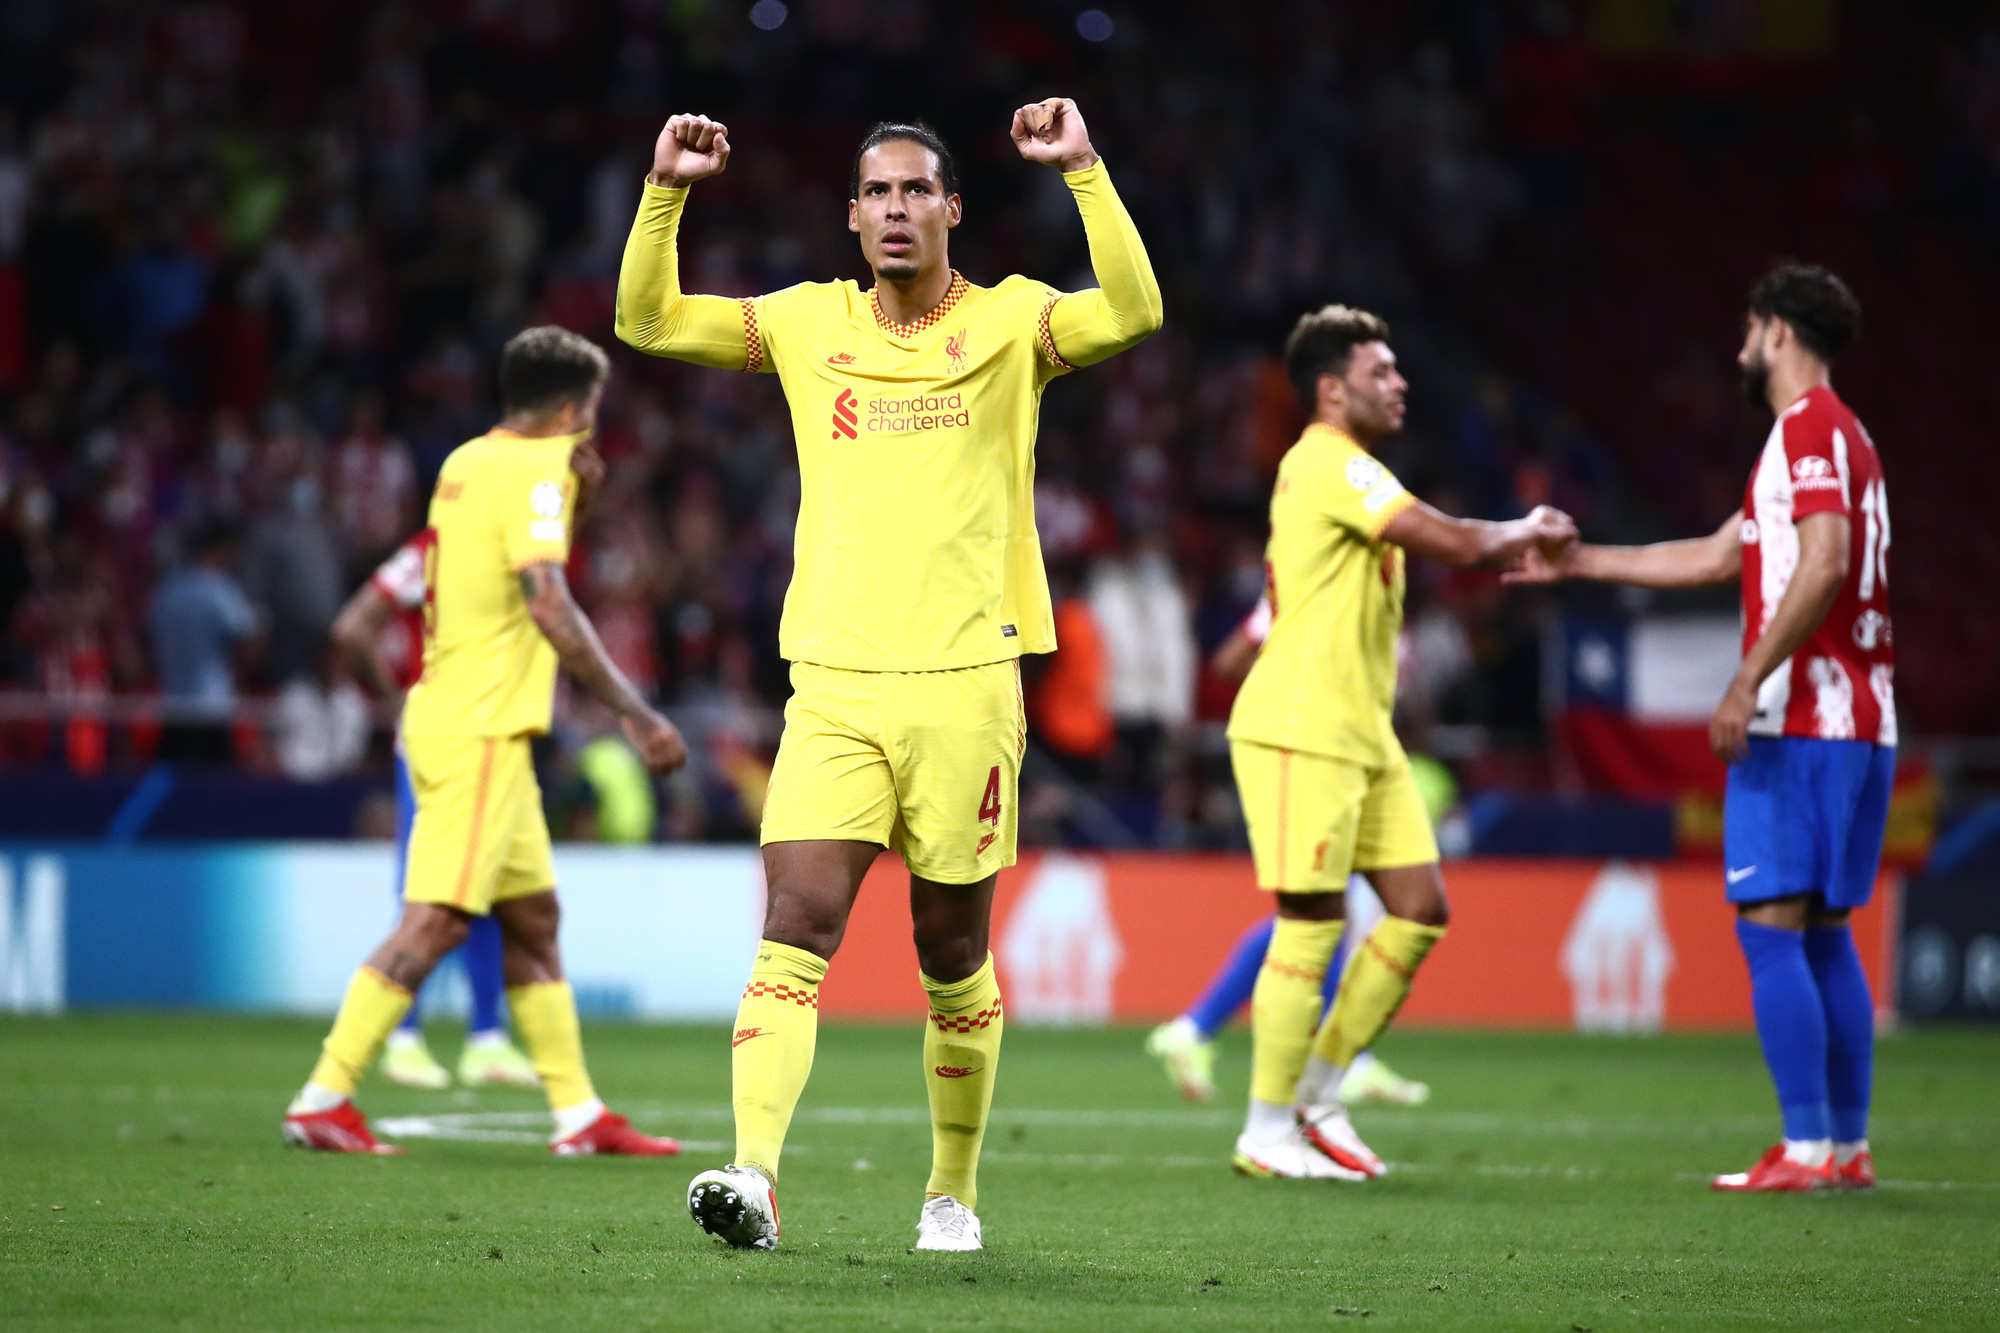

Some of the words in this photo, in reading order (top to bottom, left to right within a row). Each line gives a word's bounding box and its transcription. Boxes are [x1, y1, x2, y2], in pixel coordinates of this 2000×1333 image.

[868, 392, 962, 414] standard
[867, 409, 969, 432] chartered
[978, 765, 1002, 828] 4
[735, 1027, 762, 1039] NIKE
